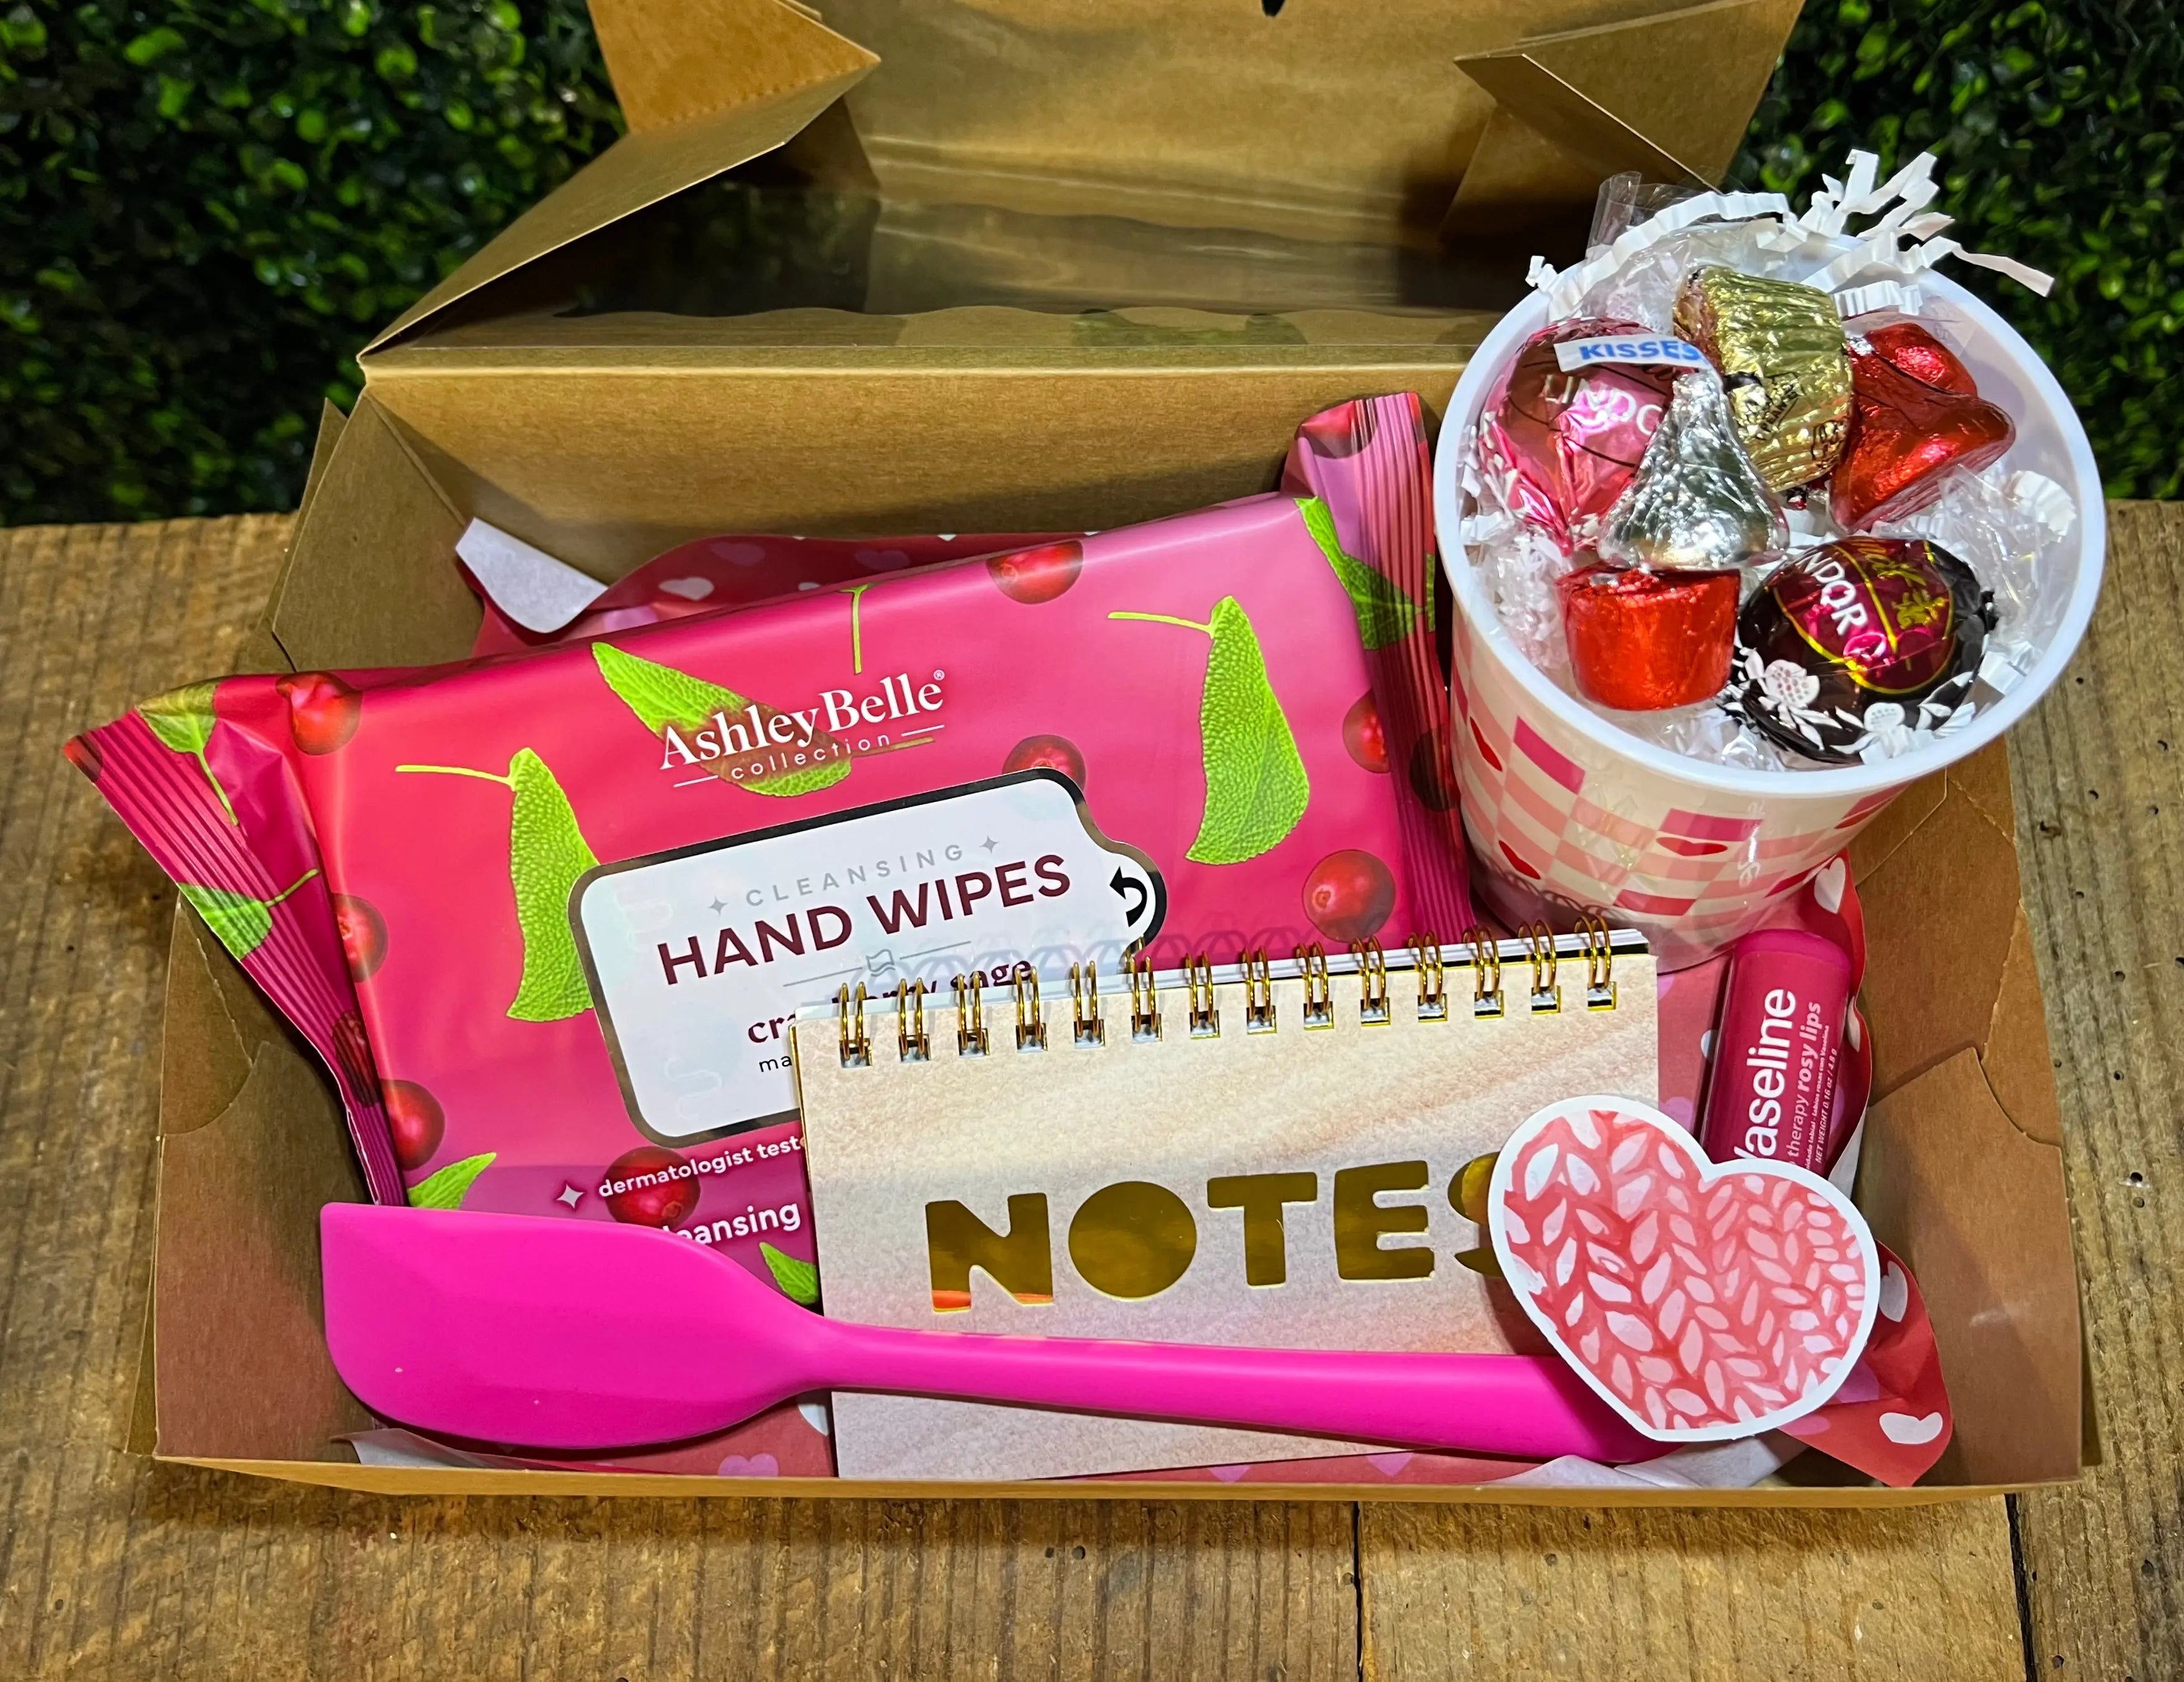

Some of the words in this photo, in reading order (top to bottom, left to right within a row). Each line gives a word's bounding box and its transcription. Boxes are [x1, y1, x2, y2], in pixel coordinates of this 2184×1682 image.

[1579, 340, 1702, 360] KISSES
[1794, 550, 1868, 636] NDOR
[731, 733, 890, 781] collection
[746, 843, 965, 906] CLEANSING
[657, 906, 853, 985] HAND
[866, 853, 1071, 935] WIPES
[1799, 1002, 1823, 1041] lips
[1797, 1043, 1819, 1092] rosy
[1786, 1094, 1809, 1157] therapy
[1808, 1121, 1816, 1144] labial
[1812, 1094, 1820, 1117] labios
[1818, 1109, 1828, 1144] WEIGHT
[598, 1146, 754, 1197] dermatologist
[1815, 1144, 1824, 1164] NET
[662, 1203, 801, 1245] ansing
